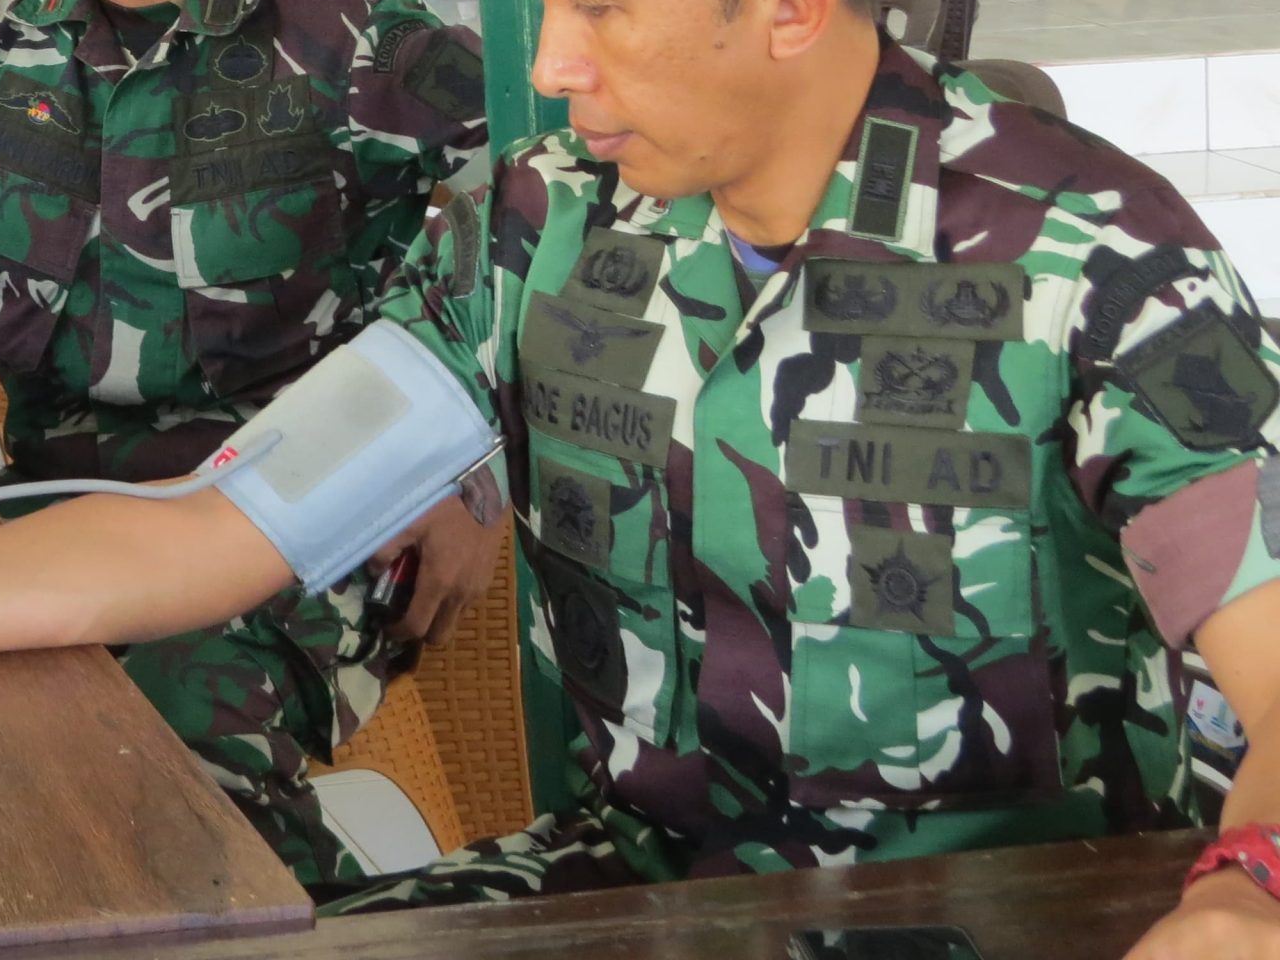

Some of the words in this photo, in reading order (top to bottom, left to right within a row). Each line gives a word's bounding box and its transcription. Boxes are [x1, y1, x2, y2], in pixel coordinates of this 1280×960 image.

[570, 391, 654, 453] BAGUS
[817, 436, 893, 487] TNI
[926, 447, 1002, 494] AD
